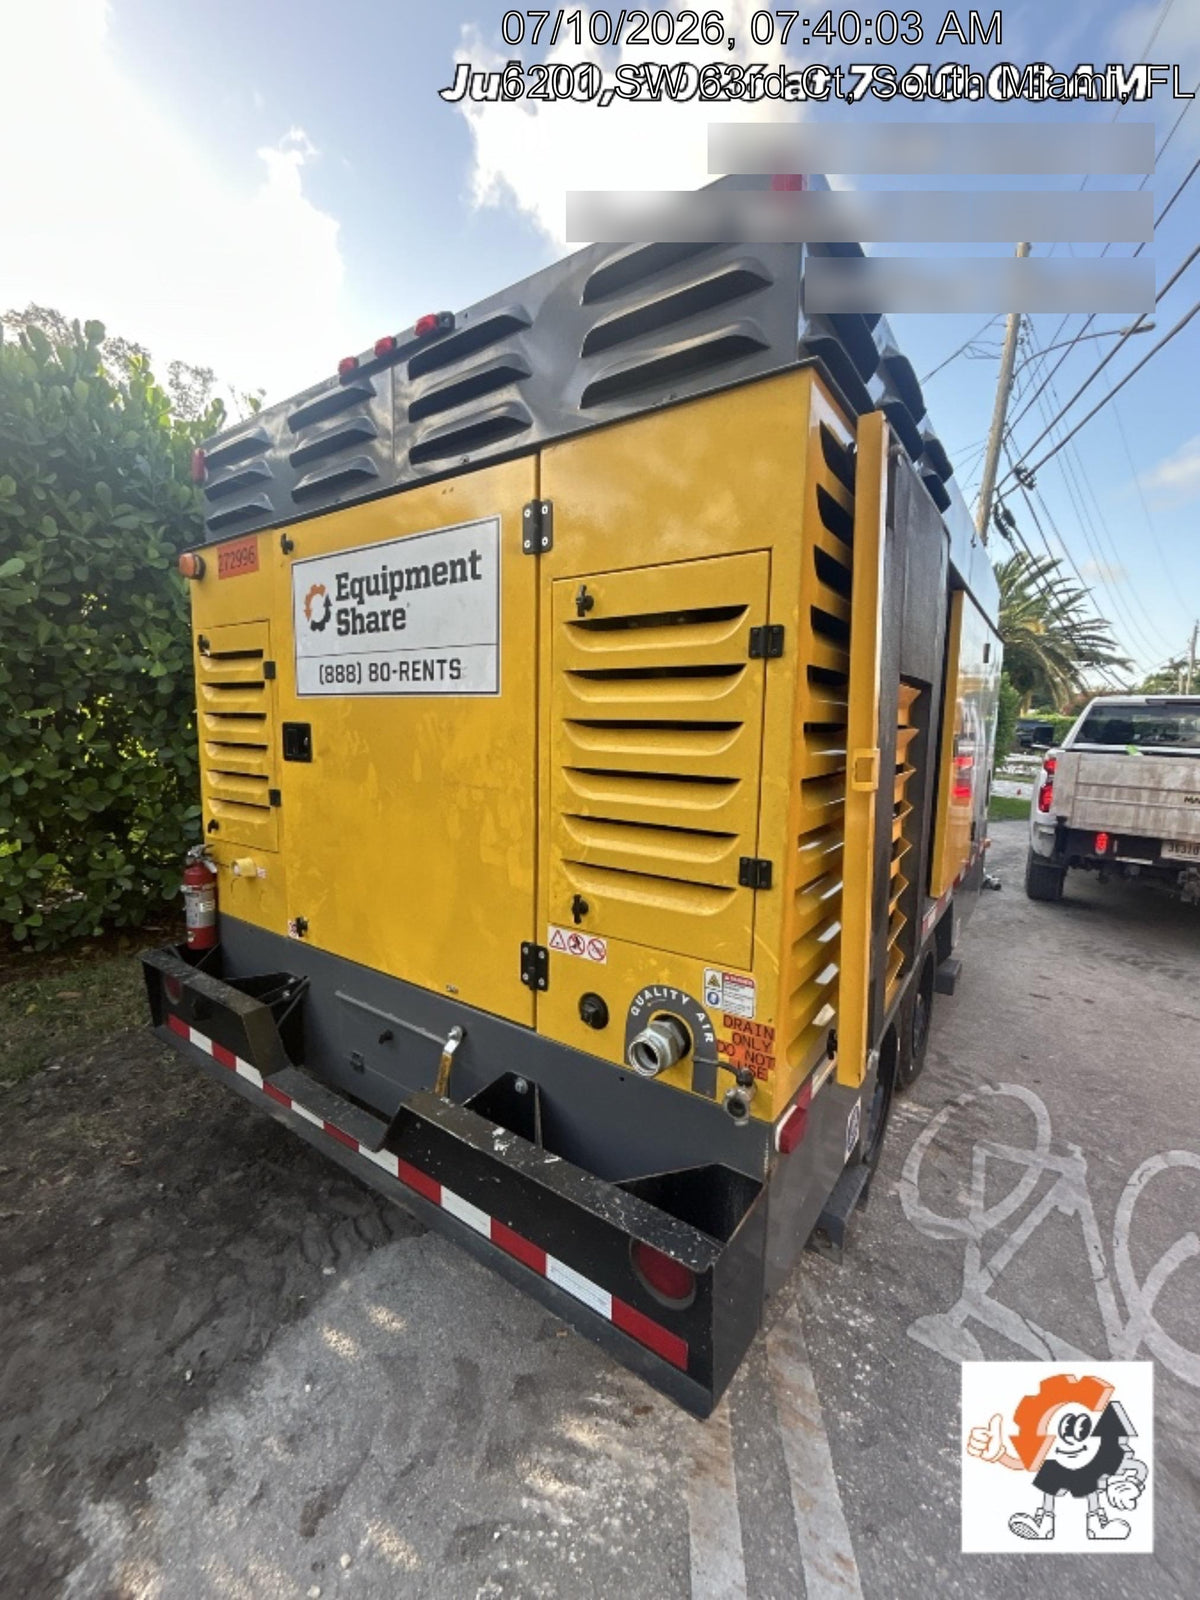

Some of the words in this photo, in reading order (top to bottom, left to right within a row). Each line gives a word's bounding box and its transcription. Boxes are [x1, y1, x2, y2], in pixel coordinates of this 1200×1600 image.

[335, 549, 482, 605] Equipment
[336, 607, 407, 636] Share
[319, 661, 362, 685] (888)
[368, 658, 462, 682] 80-RENTS
[630, 987, 690, 1016] QUALITY
[696, 1012, 714, 1043] AIR
[722, 1014, 775, 1041] DRAIN
[716, 1040, 735, 1057] DO
[745, 1050, 776, 1071] NOT
[732, 1032, 772, 1053] ONLY
